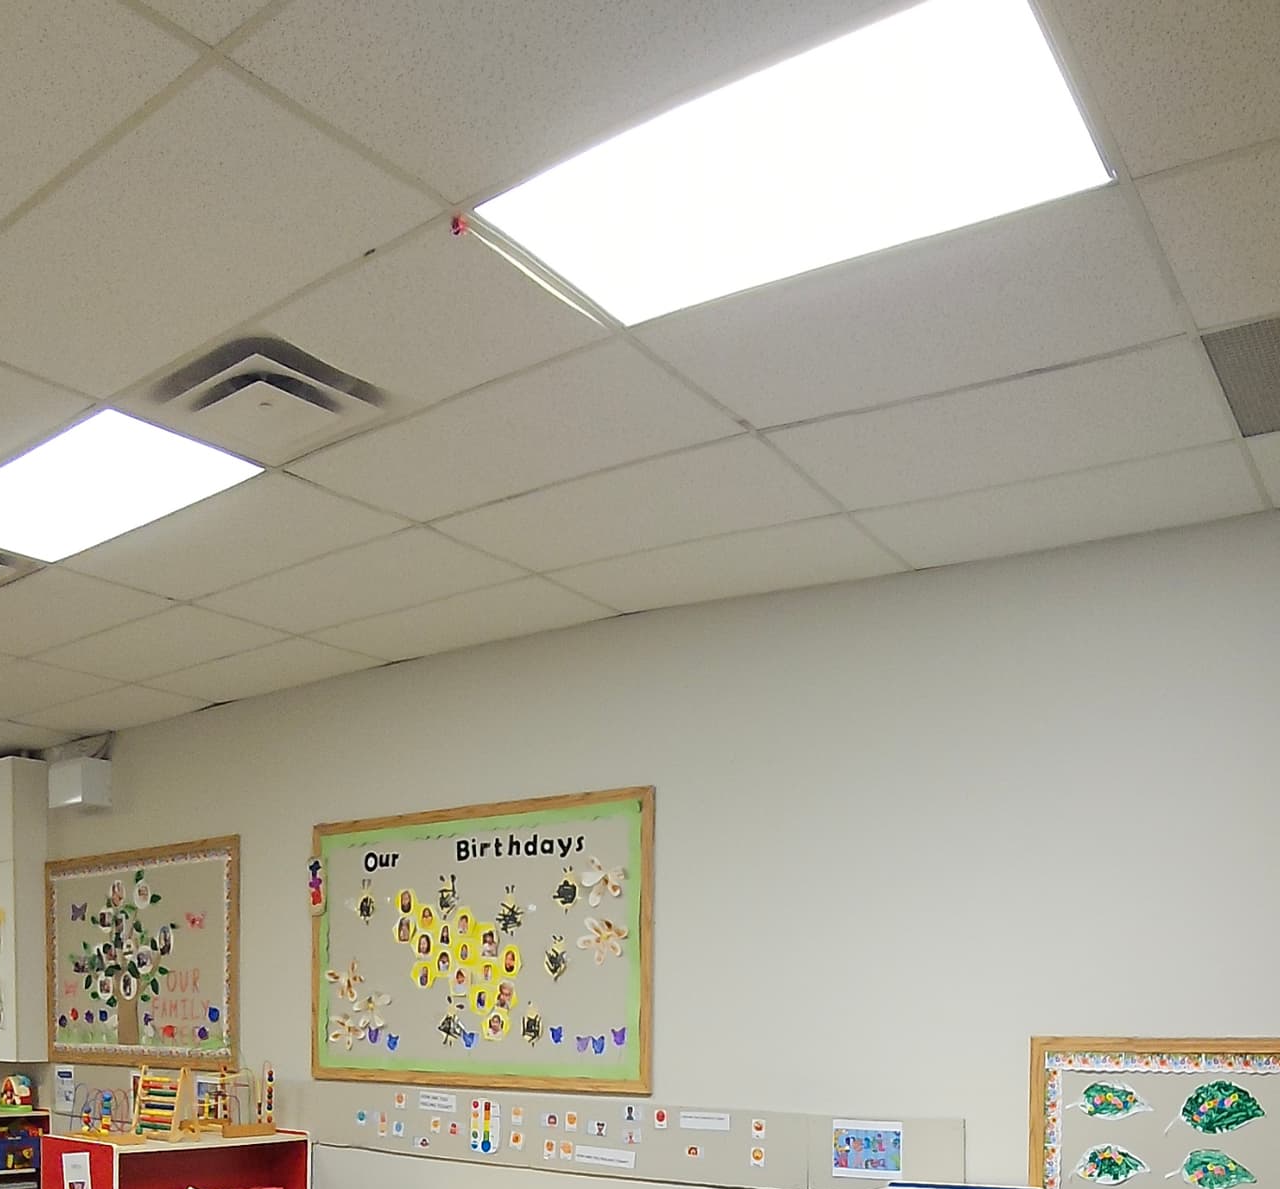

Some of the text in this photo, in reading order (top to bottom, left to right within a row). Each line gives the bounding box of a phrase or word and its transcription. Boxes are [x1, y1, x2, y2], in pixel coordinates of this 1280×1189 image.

[364, 833, 586, 873] Our Birthdays
[166, 968, 201, 993] OUR
[152, 997, 210, 1021] FAMILY
